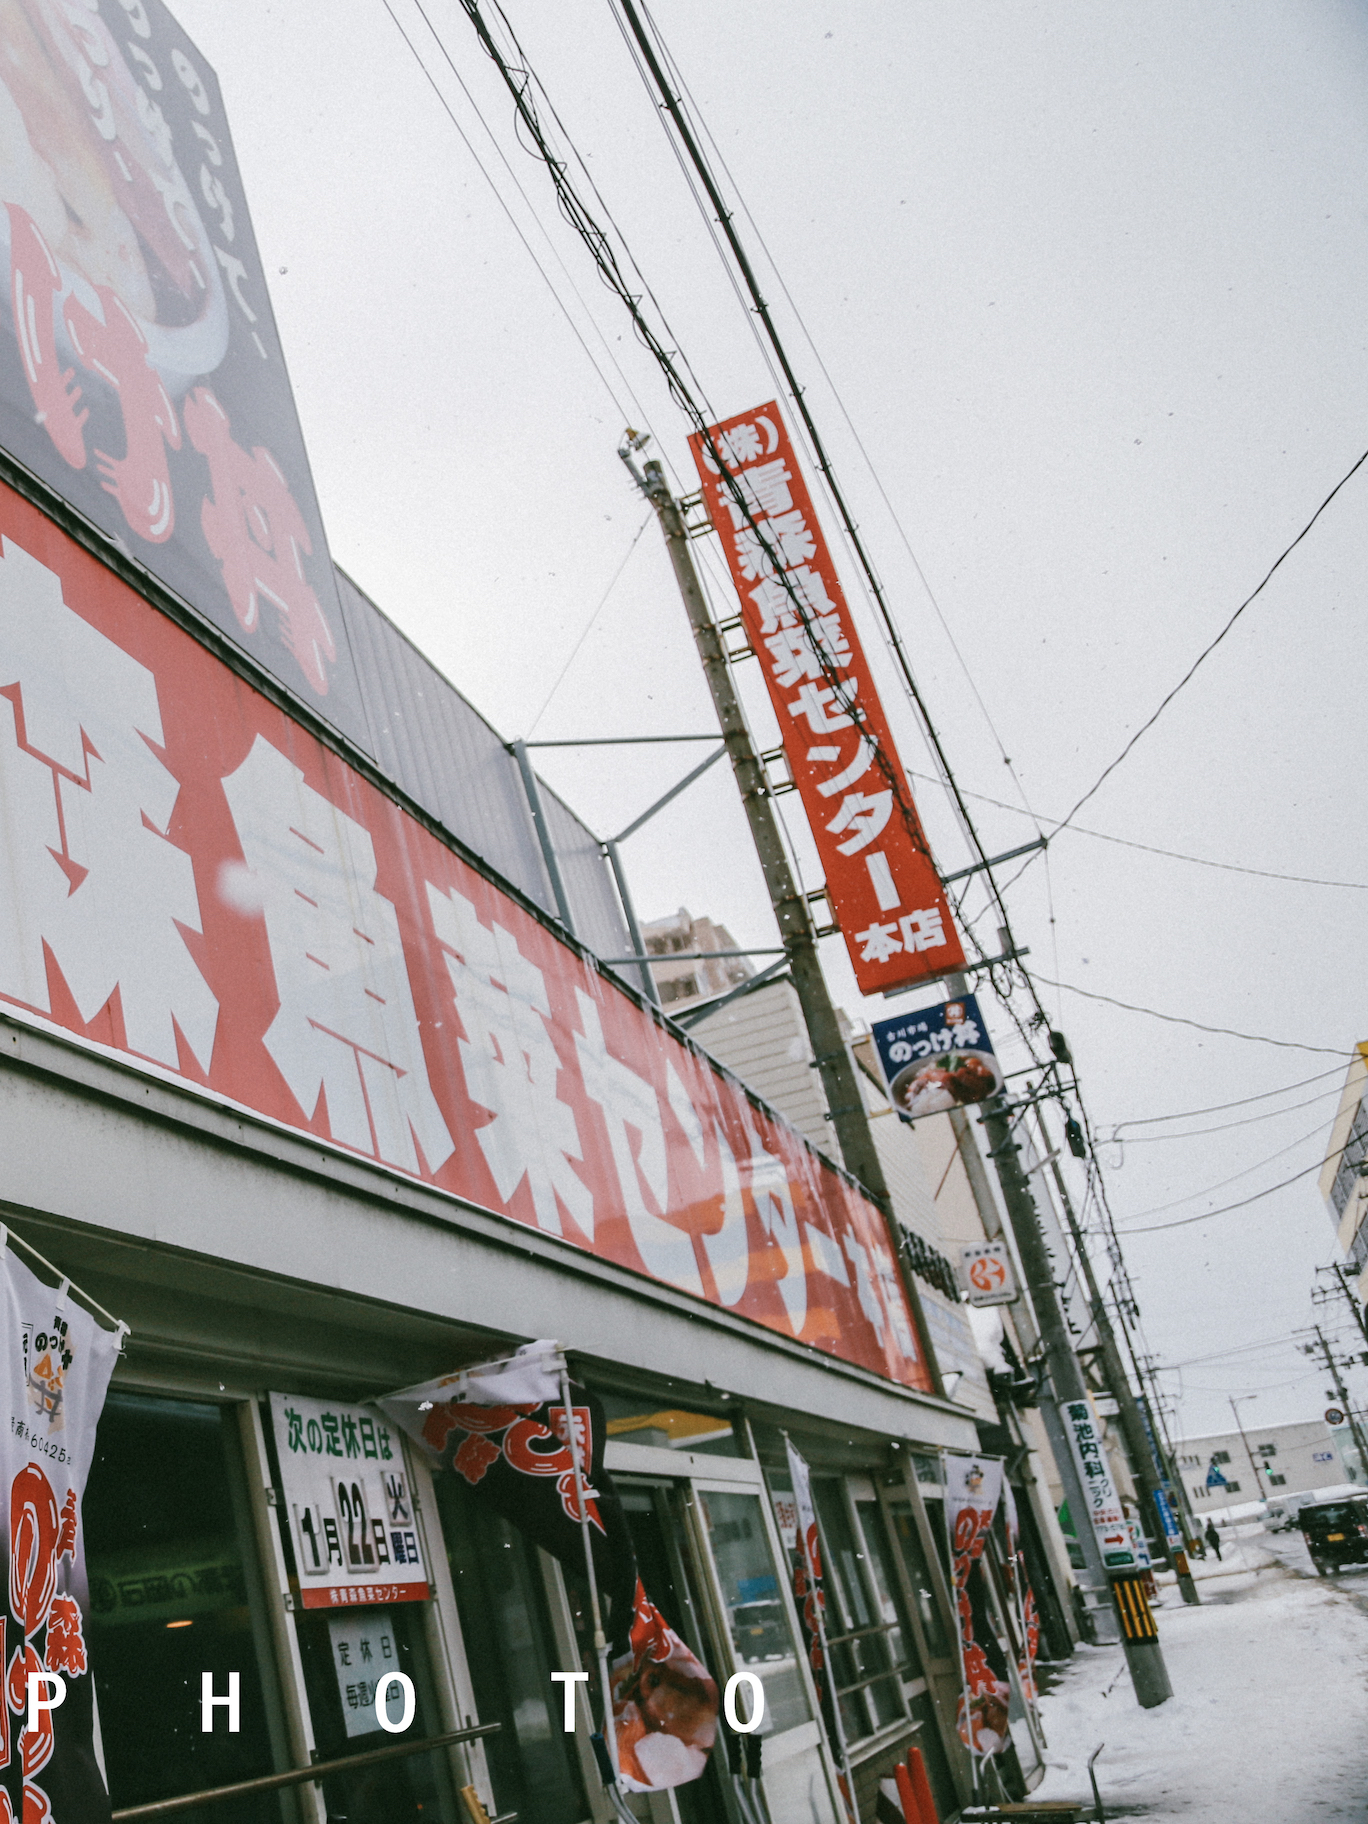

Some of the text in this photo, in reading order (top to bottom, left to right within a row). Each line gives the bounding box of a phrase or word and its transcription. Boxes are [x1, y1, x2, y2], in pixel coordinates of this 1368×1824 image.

[854, 907, 944, 964] 本店
[888, 1020, 981, 1063] のっけ丼
[284, 1407, 393, 1460] 次の定休日は
[338, 1635, 392, 1667] 定休日
